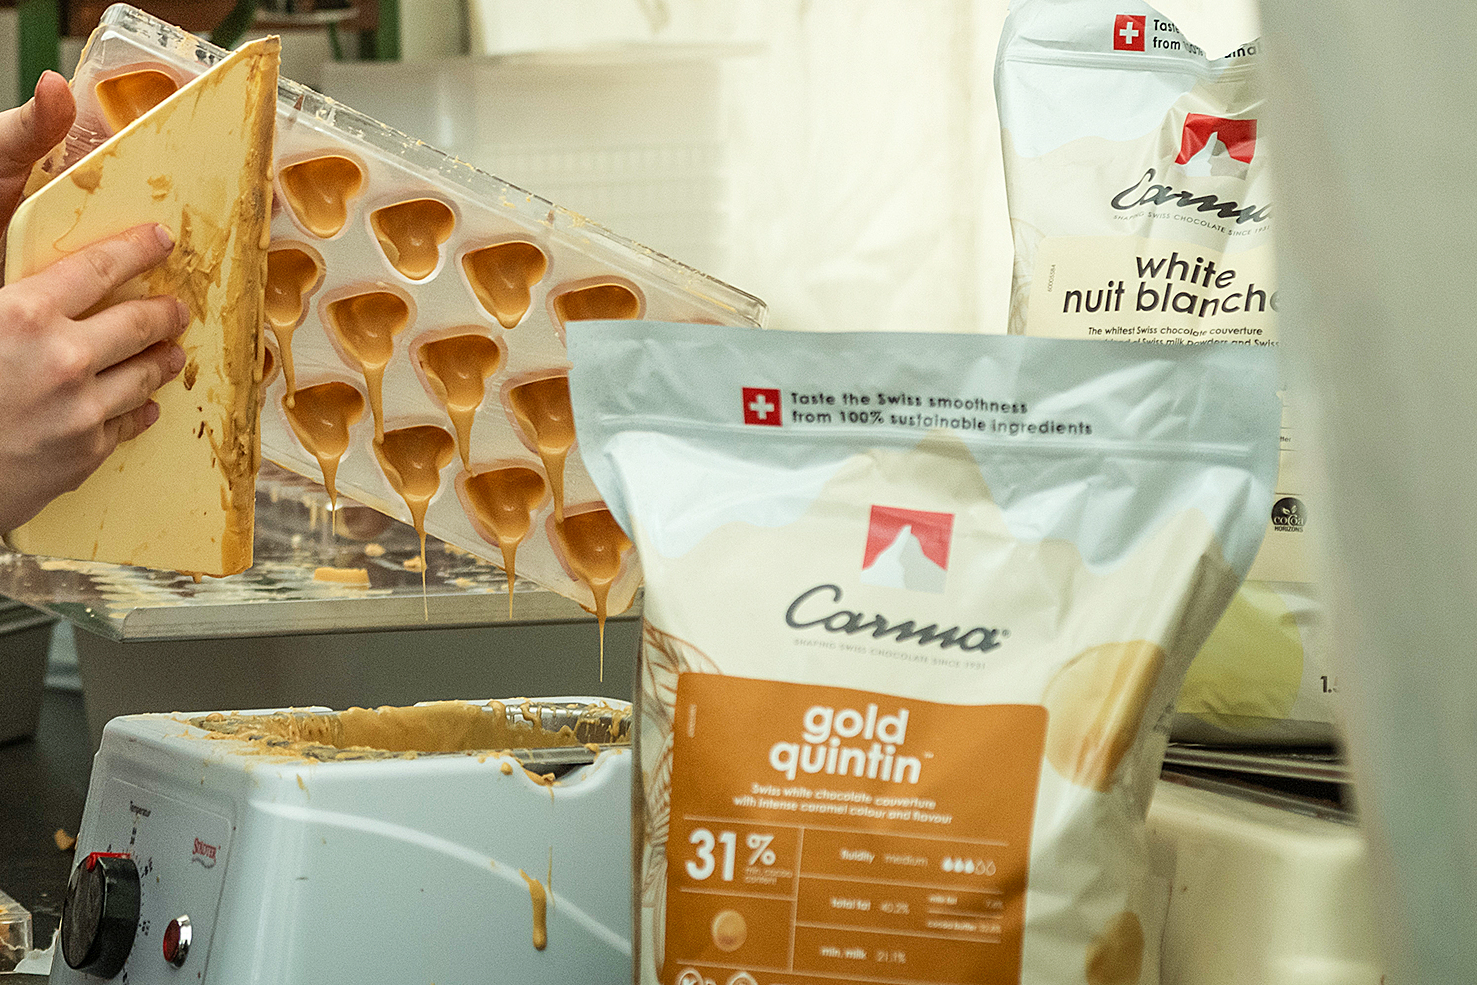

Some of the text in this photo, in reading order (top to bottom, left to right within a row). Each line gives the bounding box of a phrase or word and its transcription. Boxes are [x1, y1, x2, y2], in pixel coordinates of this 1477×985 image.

[1153, 36, 1181, 50] from
[1148, 211, 1171, 220] SWISS
[1173, 213, 1225, 234] CHOCOLATE
[1227, 228, 1252, 236] SINCE
[1135, 252, 1236, 289] white
[1063, 280, 1126, 314] nuit
[1088, 325, 1263, 337] The whitest Swiss chocolate couverture
[791, 391, 1028, 415] Taste the Swiss smoothness
[791, 409, 1092, 436] from 100% sustainable ingredients
[802, 703, 910, 745] gold
[751, 782, 936, 810] Swiss white chocolate couverture
[733, 795, 952, 825] with intense caramel colour and flavour
[840, 849, 875, 865] fluidity
[830, 897, 855, 911] total
